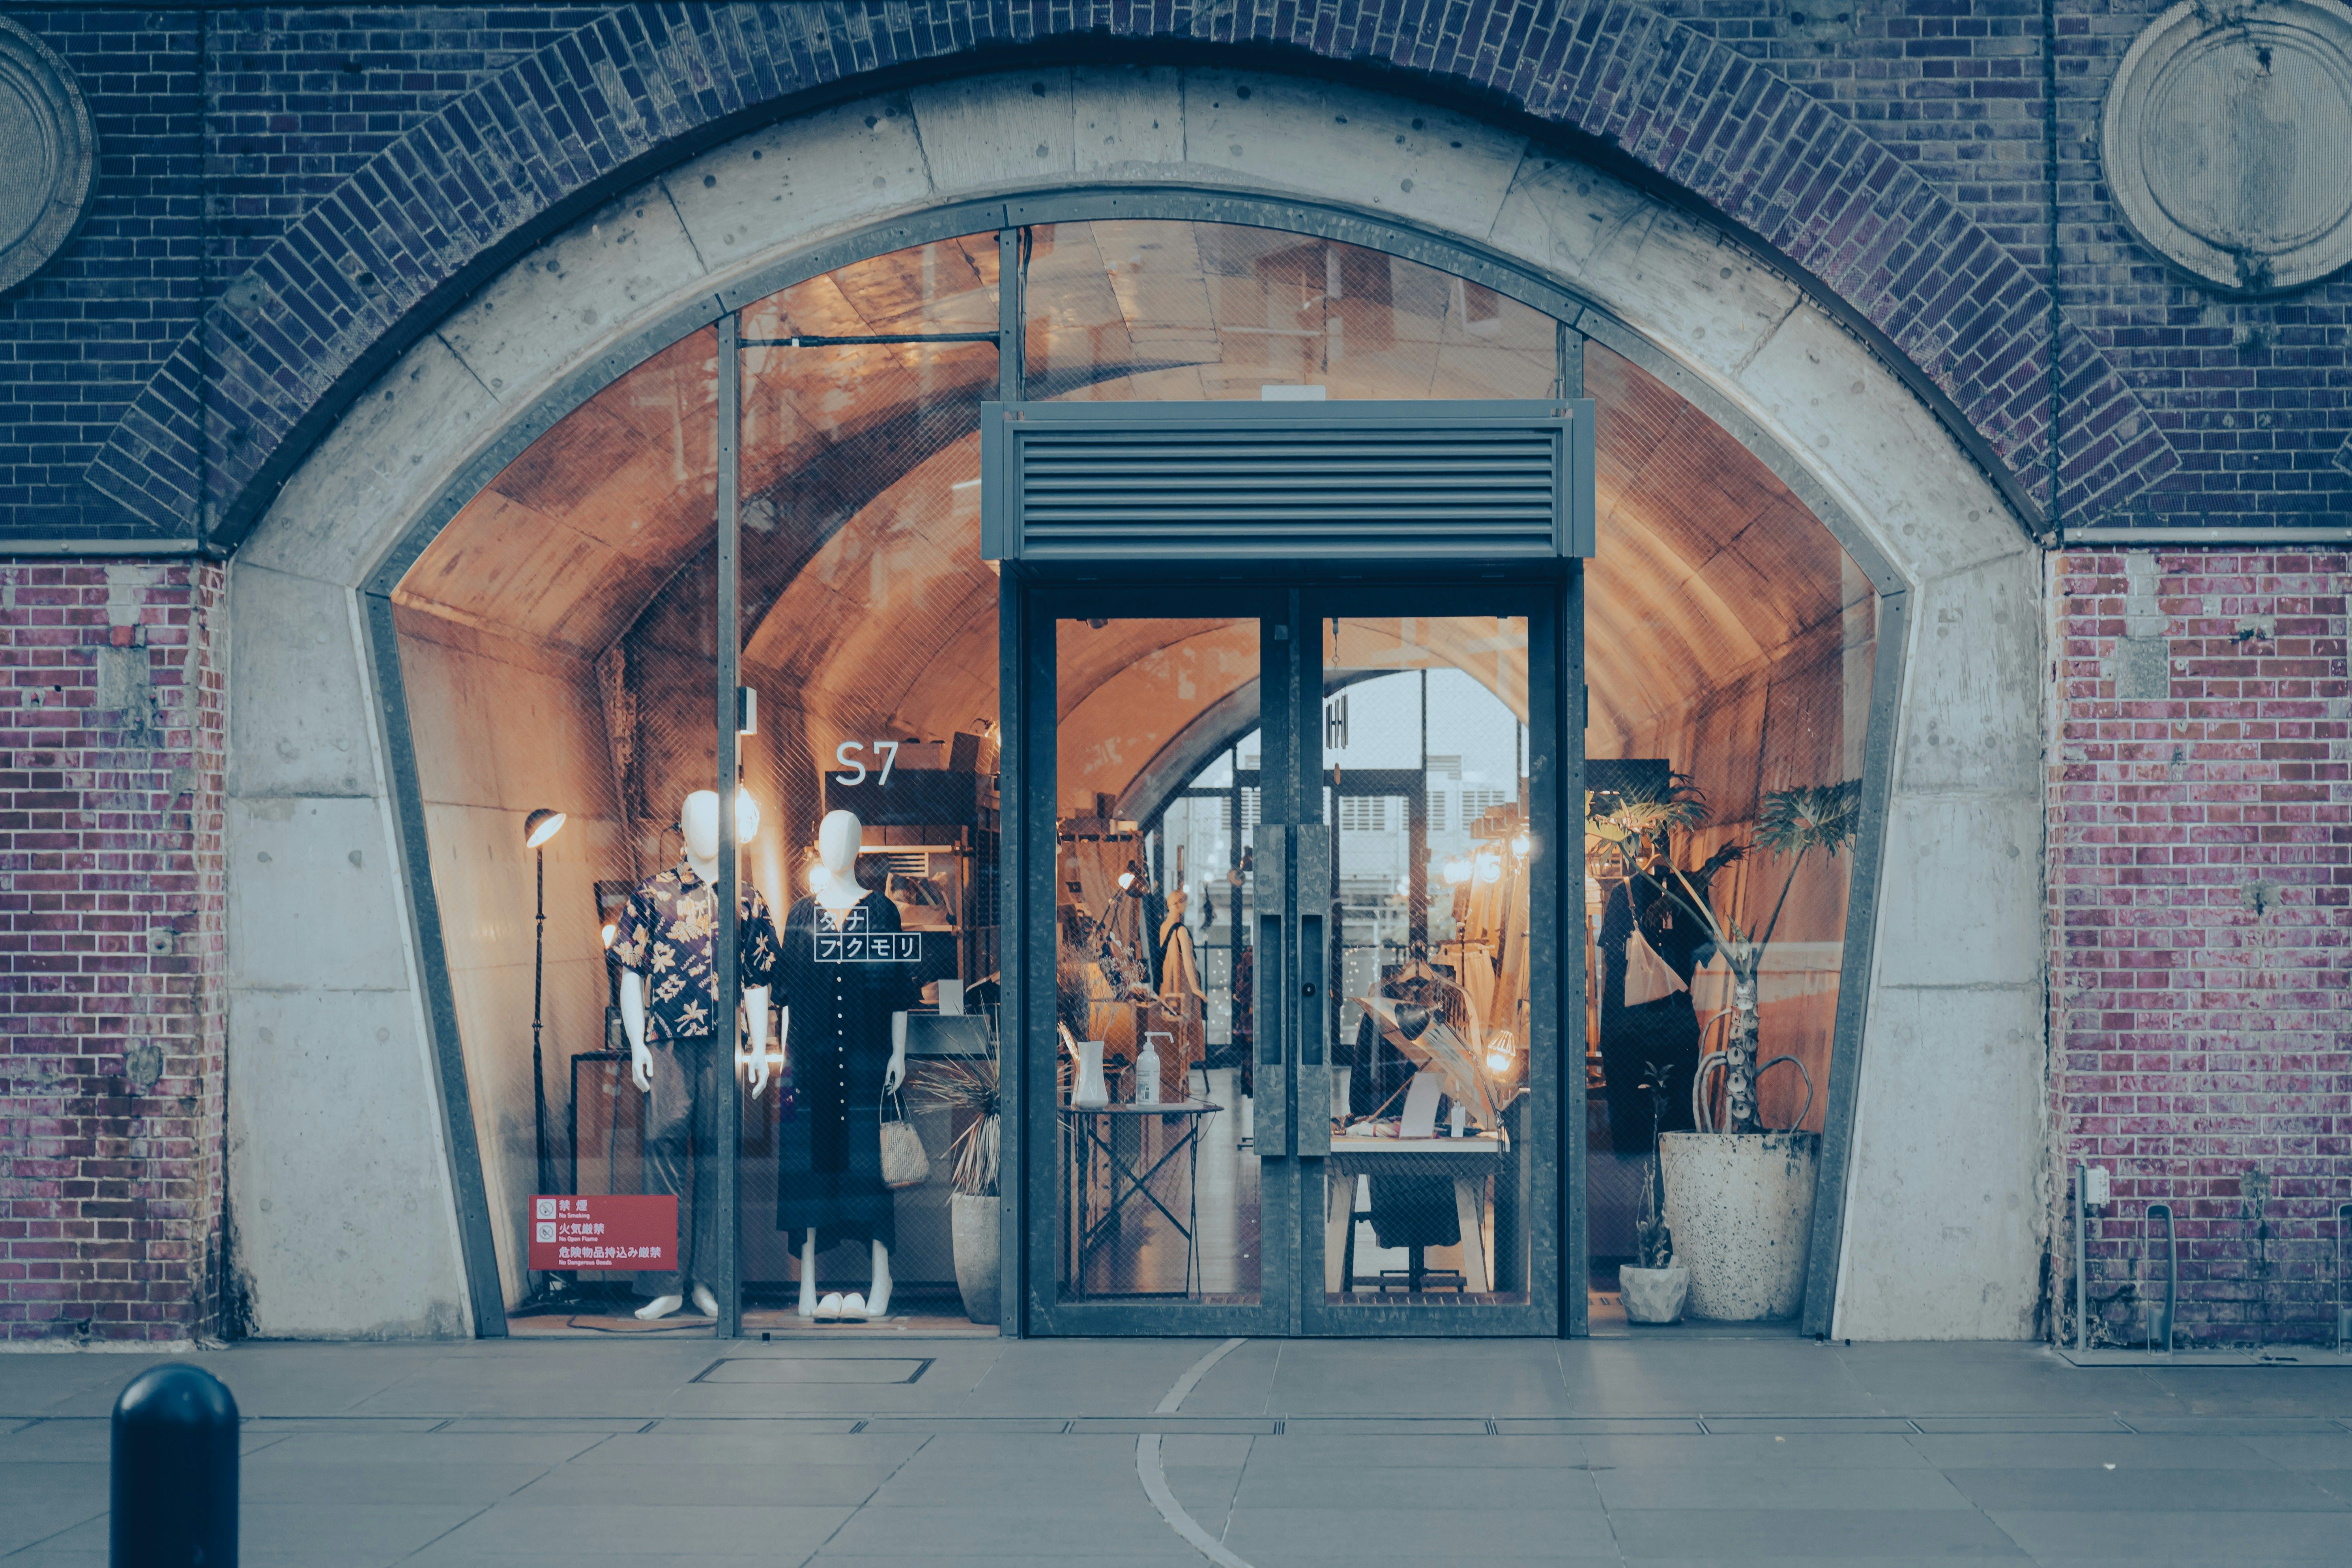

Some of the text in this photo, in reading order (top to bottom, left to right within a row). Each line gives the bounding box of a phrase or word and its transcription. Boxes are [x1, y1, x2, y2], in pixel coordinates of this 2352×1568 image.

[835, 741, 898, 786] S7
[819, 911, 864, 931] タナ
[820, 937, 913, 958] フクモリ
[559, 1199, 588, 1212] 禁煙
[559, 1223, 605, 1235] 火気厳禁
[559, 1246, 661, 1259] 危険物品持込み厳禁
